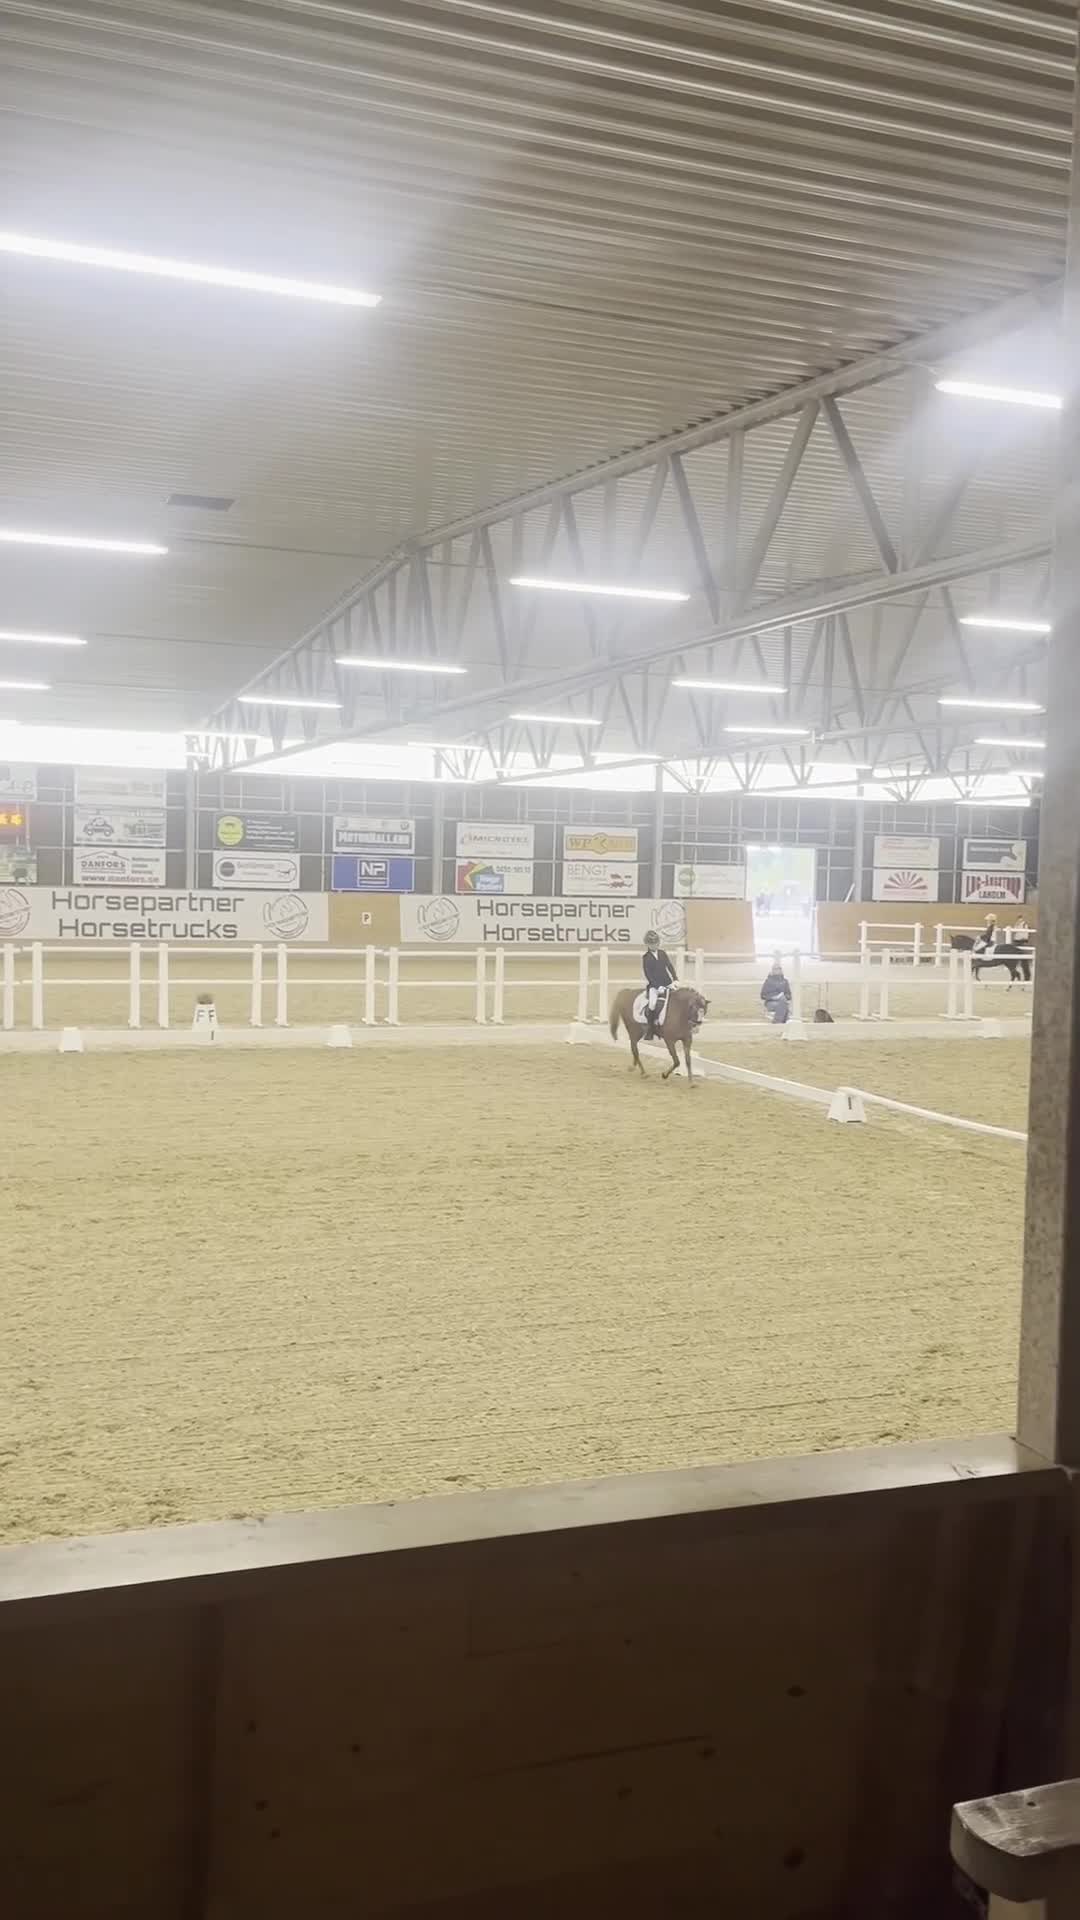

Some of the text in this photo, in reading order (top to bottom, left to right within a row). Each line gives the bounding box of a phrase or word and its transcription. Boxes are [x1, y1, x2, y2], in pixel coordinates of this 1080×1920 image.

[361, 861, 386, 876] NP
[52, 891, 245, 916] Horsepartner
[477, 899, 635, 922] Horsepartner
[58, 918, 238, 939] Horsetrucks
[483, 923, 631, 942] Horsetrucks
